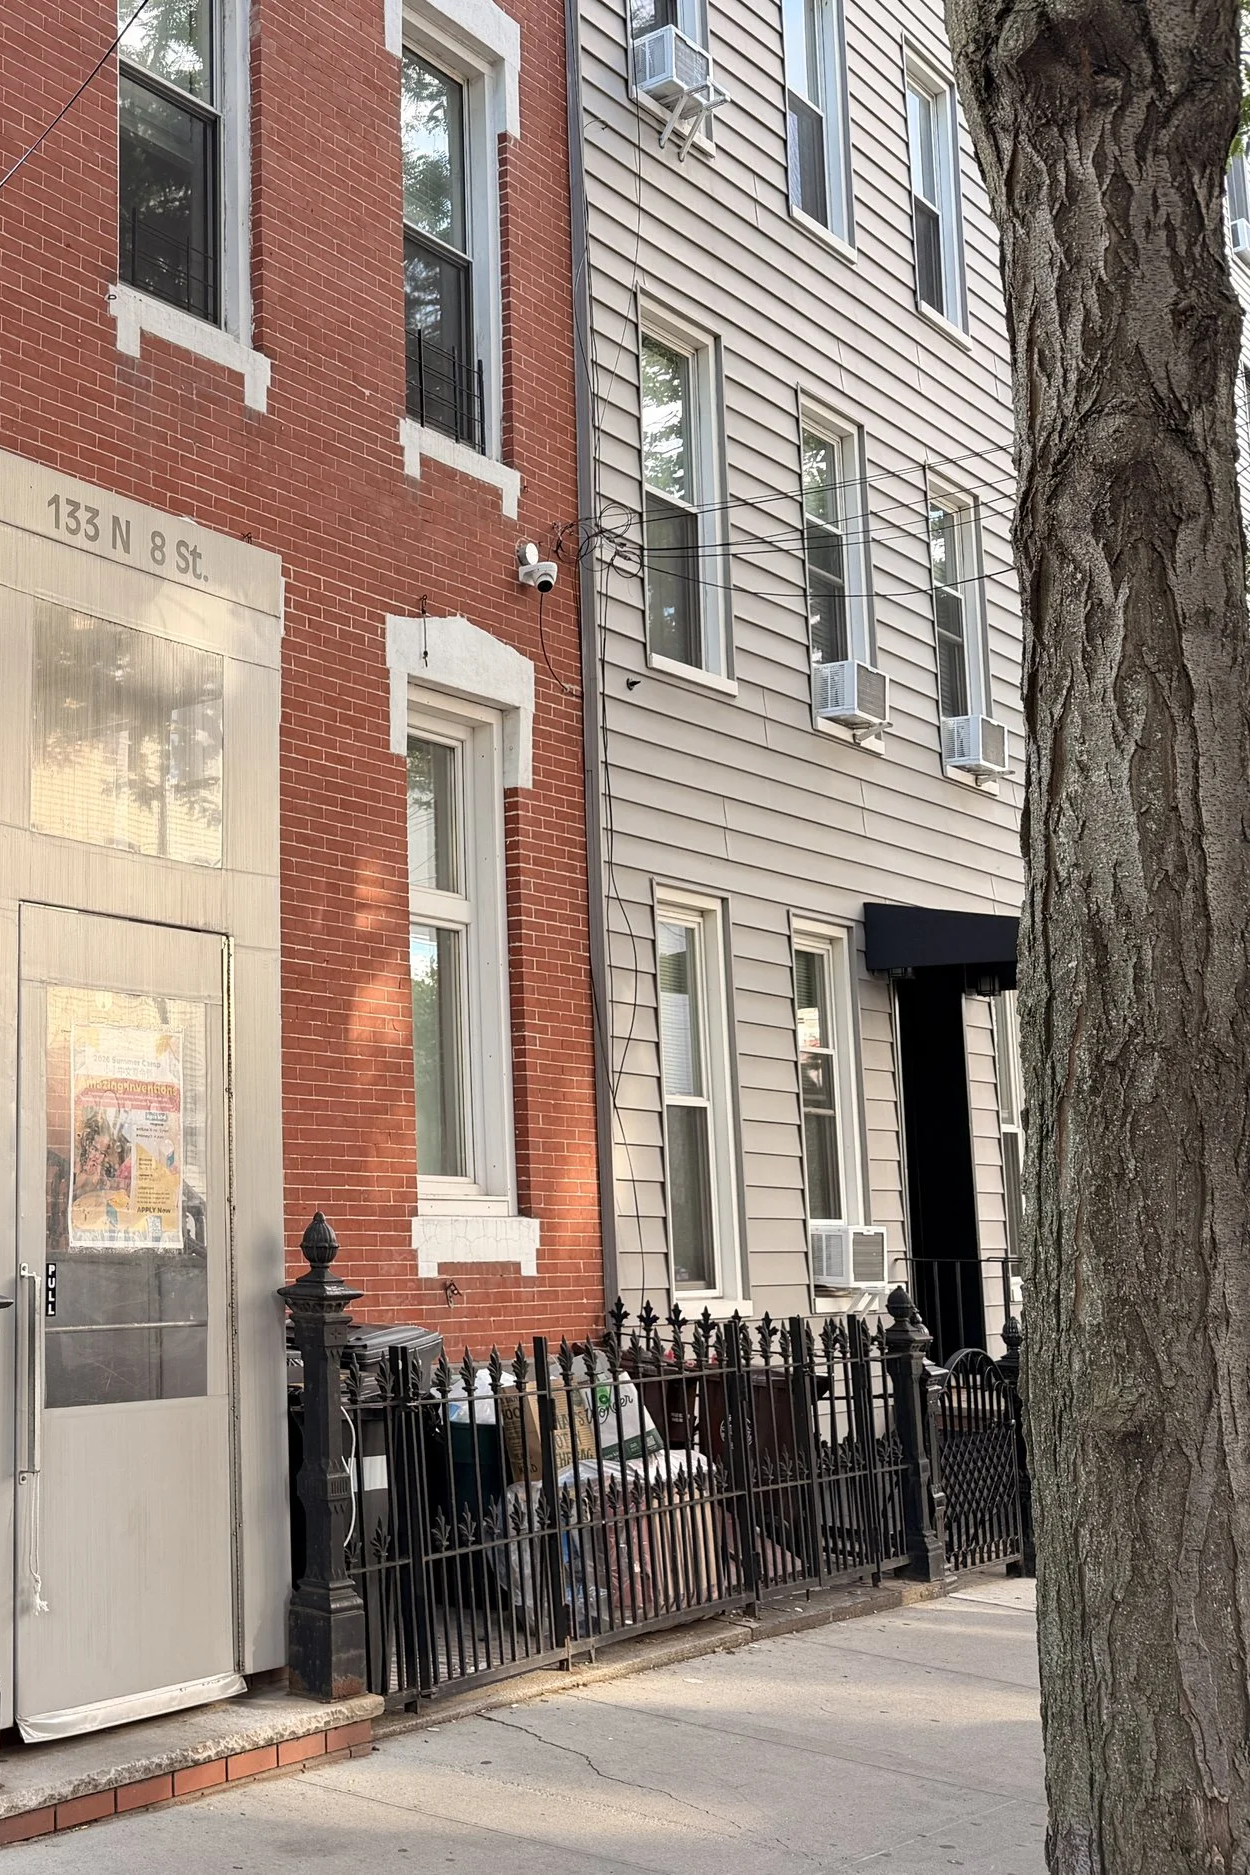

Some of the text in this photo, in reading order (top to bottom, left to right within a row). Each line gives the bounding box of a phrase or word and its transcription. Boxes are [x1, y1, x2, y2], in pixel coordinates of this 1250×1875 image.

[47, 493, 209, 582] 133 N 8 St.
[111, 1056, 140, 1066] Summer
[141, 1059, 161, 1070] Camp
[137, 1206, 156, 1214] APPLY
[48, 1264, 56, 1315] PULL
